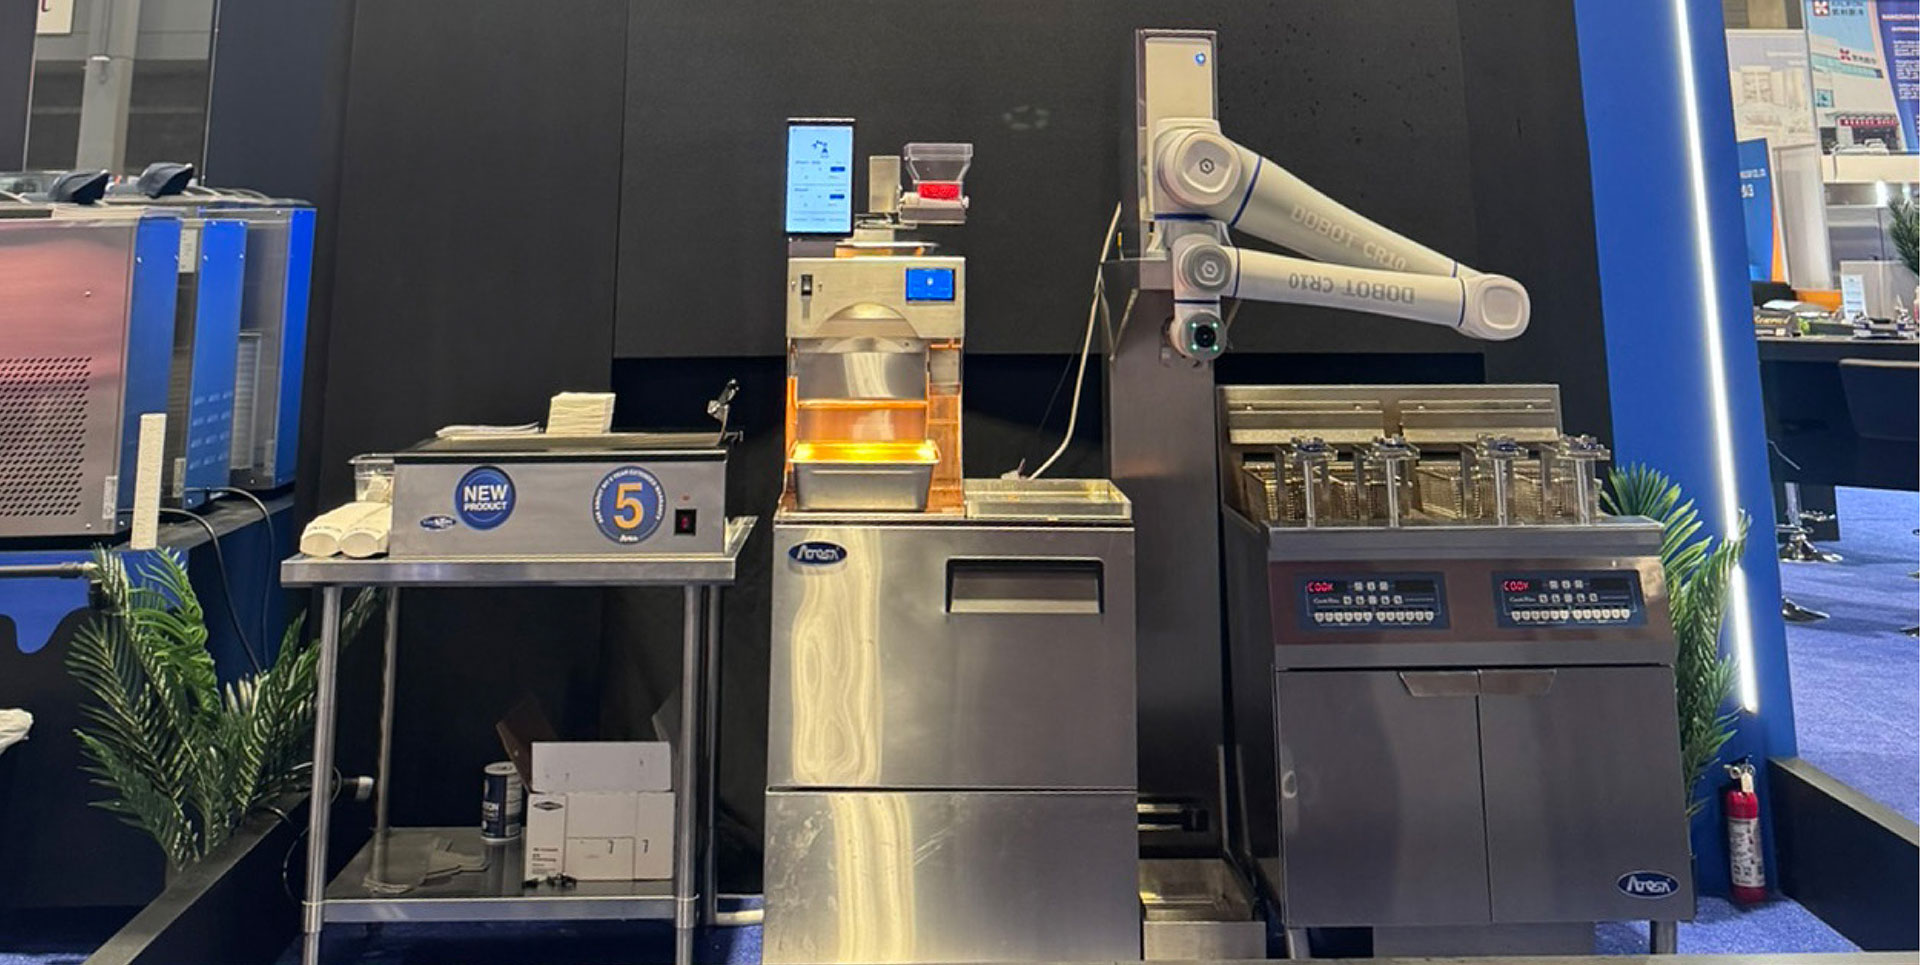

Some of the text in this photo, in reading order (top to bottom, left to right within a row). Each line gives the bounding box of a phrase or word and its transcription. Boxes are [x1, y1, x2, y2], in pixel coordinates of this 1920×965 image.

[1290, 203, 1407, 270] DOBOT CR10
[1288, 272, 1416, 304] DOBOT CR10
[463, 484, 508, 502] NEW
[463, 501, 508, 512] PRODUCT
[614, 482, 644, 530] 5
